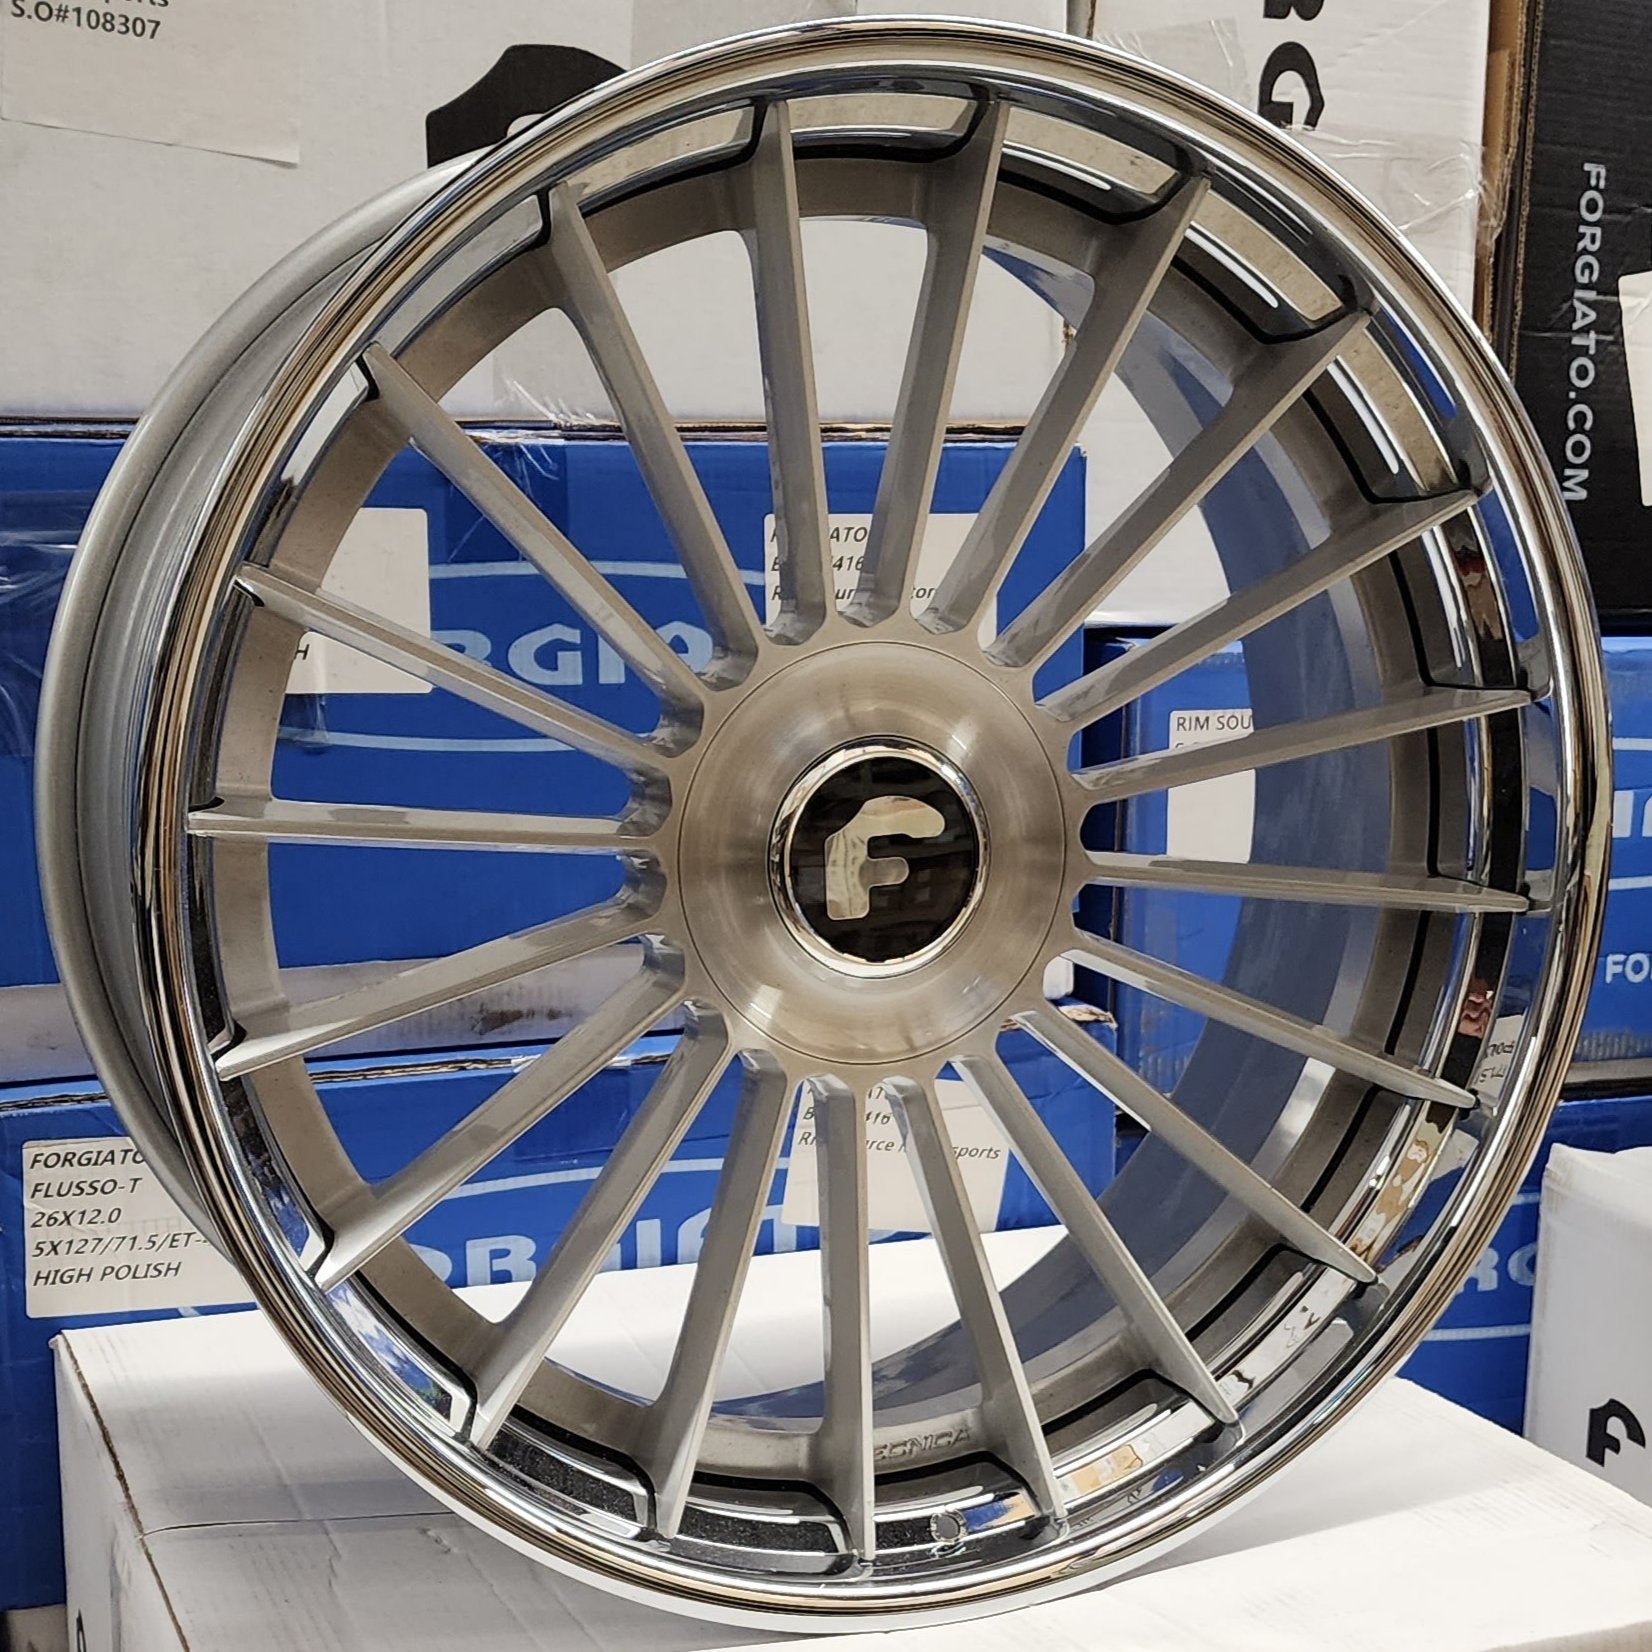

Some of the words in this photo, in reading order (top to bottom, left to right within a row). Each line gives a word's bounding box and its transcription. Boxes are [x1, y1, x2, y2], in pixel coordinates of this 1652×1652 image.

[1561, 162, 1606, 500] FORGIATO.COM
[1176, 715, 1210, 731] RIM
[1605, 952, 1652, 984] FO
[30, 1177, 143, 1199] FLUSSO-T
[30, 1207, 122, 1228] 26X12.0
[31, 1231, 210, 1258] 5X127/71.5/ET-
[32, 1266, 94, 1287] HIGH
[99, 1261, 182, 1282] POLISH
[873, 1429, 970, 1460] ECNICA
